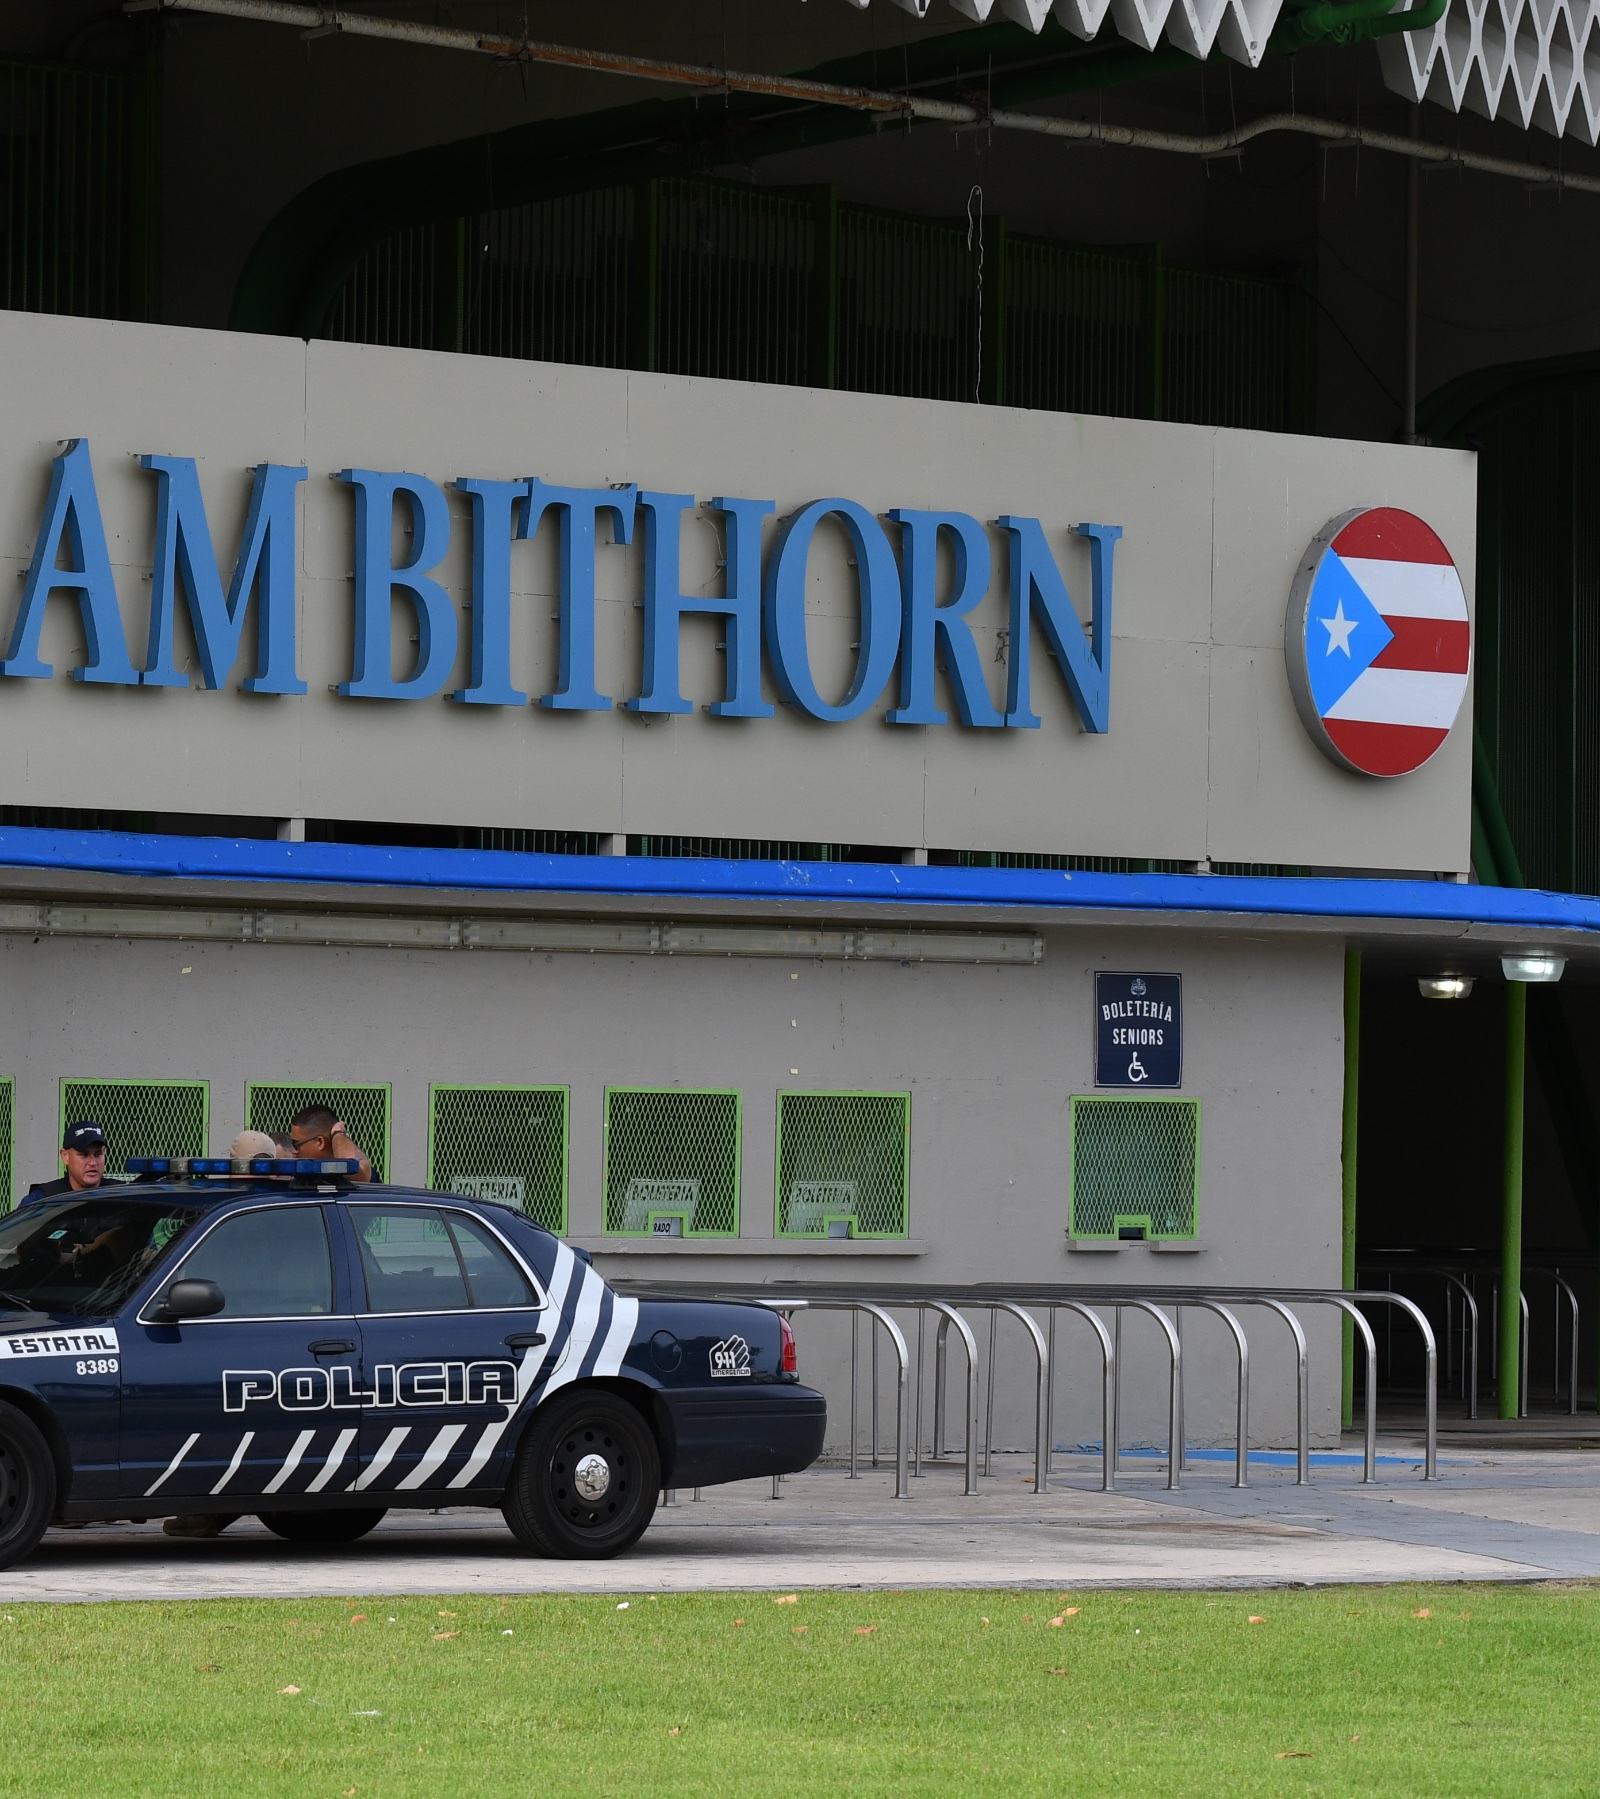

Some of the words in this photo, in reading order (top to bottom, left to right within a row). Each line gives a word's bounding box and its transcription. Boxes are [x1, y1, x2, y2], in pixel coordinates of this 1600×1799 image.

[338, 468, 1123, 733] BITHORN
[1102, 1000, 1172, 1022] BOLETERÍA
[1112, 1028, 1163, 1045] SENIORS
[652, 1222, 671, 1233] RADO
[7, 1334, 117, 1354] ESTATAL
[75, 1358, 119, 1375] 8389
[222, 1361, 518, 1412] POLICIA
